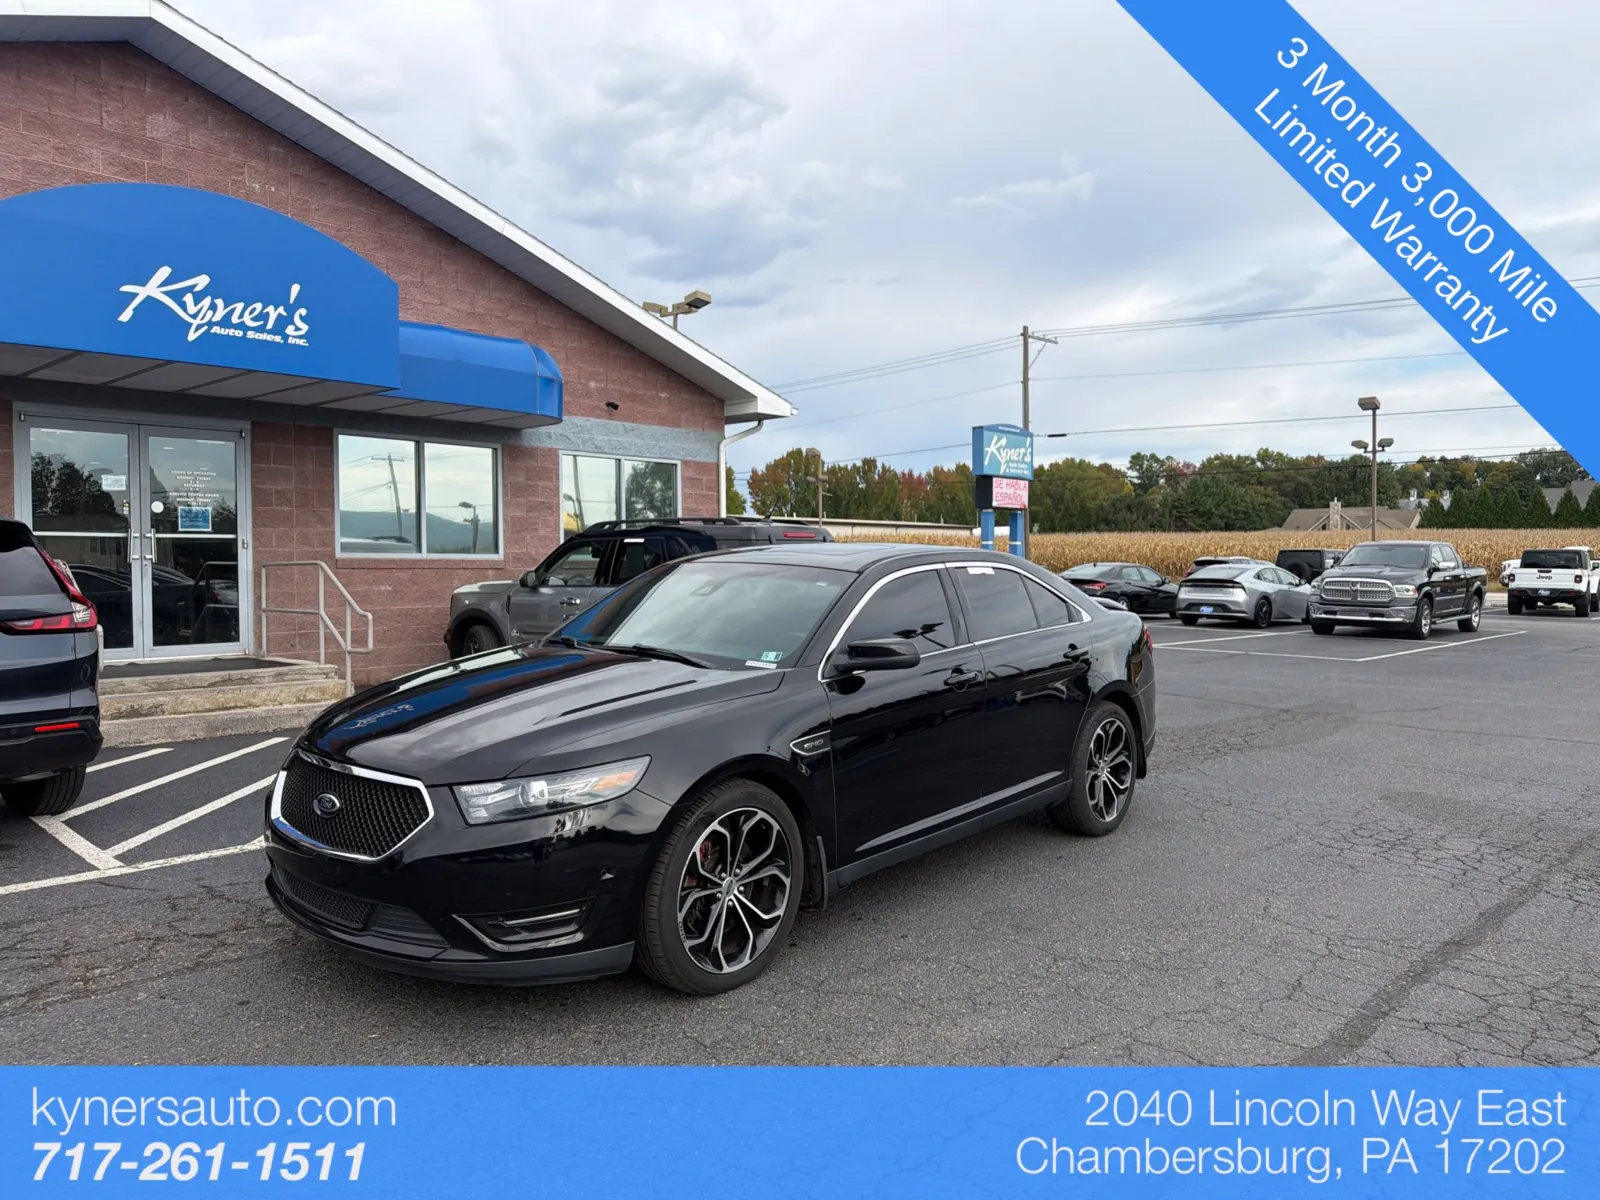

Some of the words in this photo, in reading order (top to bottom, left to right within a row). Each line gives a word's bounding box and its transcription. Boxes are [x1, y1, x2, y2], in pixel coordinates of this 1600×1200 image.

[117, 265, 309, 342] Kyner's
[210, 325, 243, 337] Auto
[246, 330, 284, 344] Sales,
[288, 336, 309, 346] Inc.
[984, 434, 1031, 475] Kyner's
[994, 479, 1004, 489] SE
[1006, 480, 1027, 492] HABLA
[995, 491, 1025, 504] ESPAÑOL
